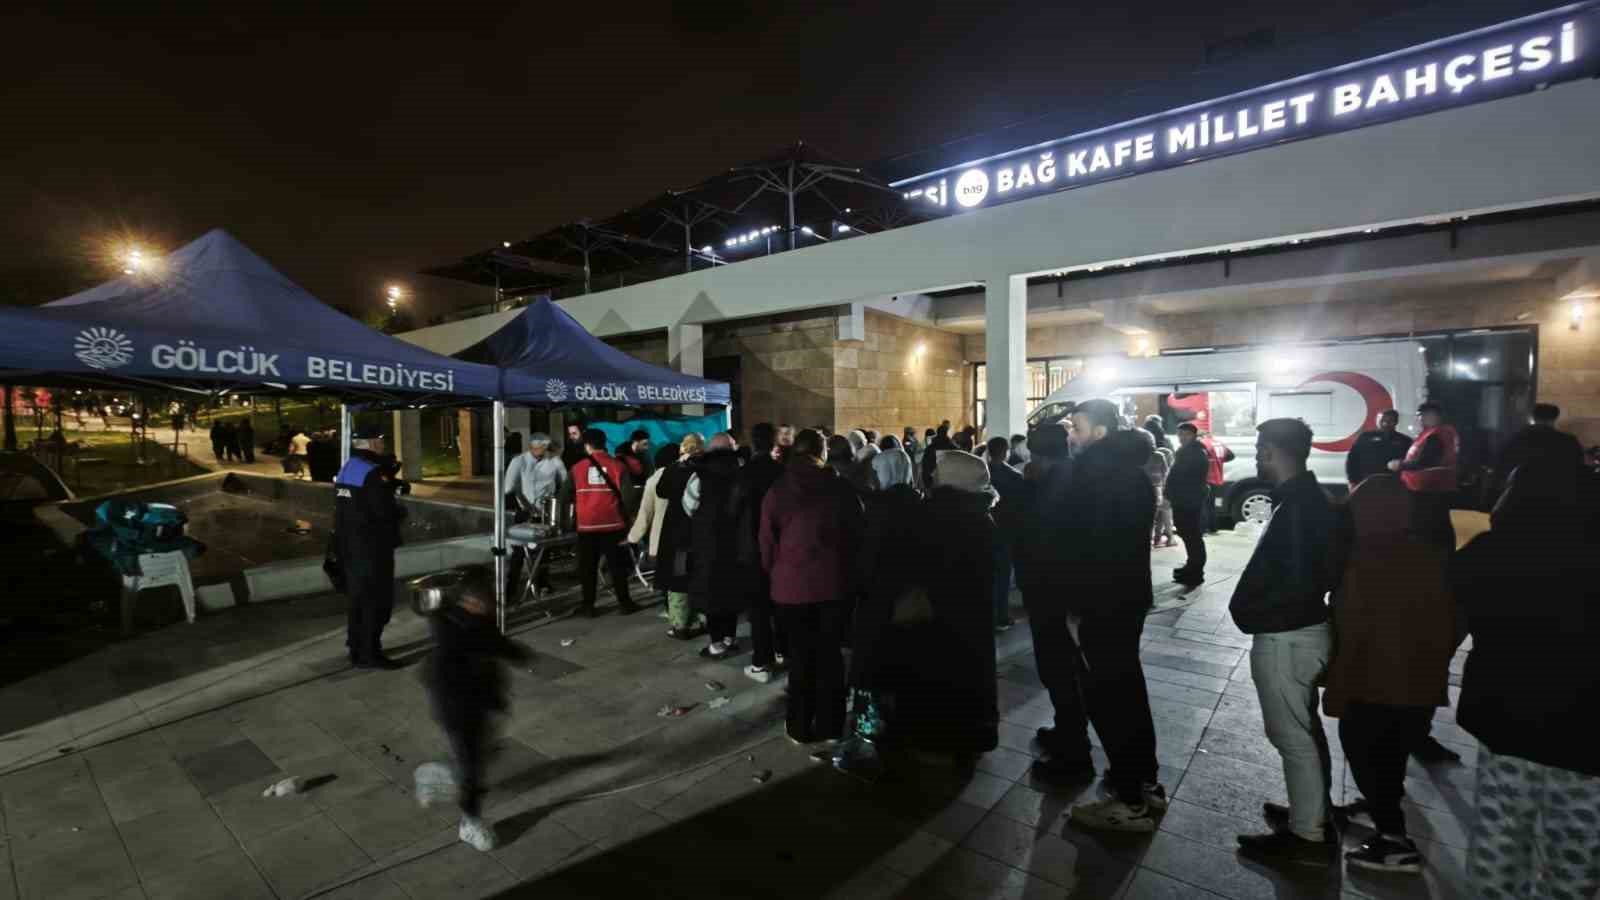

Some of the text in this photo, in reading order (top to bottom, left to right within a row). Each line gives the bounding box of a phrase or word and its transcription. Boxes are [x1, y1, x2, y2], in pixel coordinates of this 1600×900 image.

[997, 22, 1577, 193] BAĞ KAFE MİLLET BAHÇESİ
[151, 340, 454, 393] GÖLCÜK BELEDİYESİ
[574, 382, 706, 402] GÖLCÜK BELEDİYESİ
